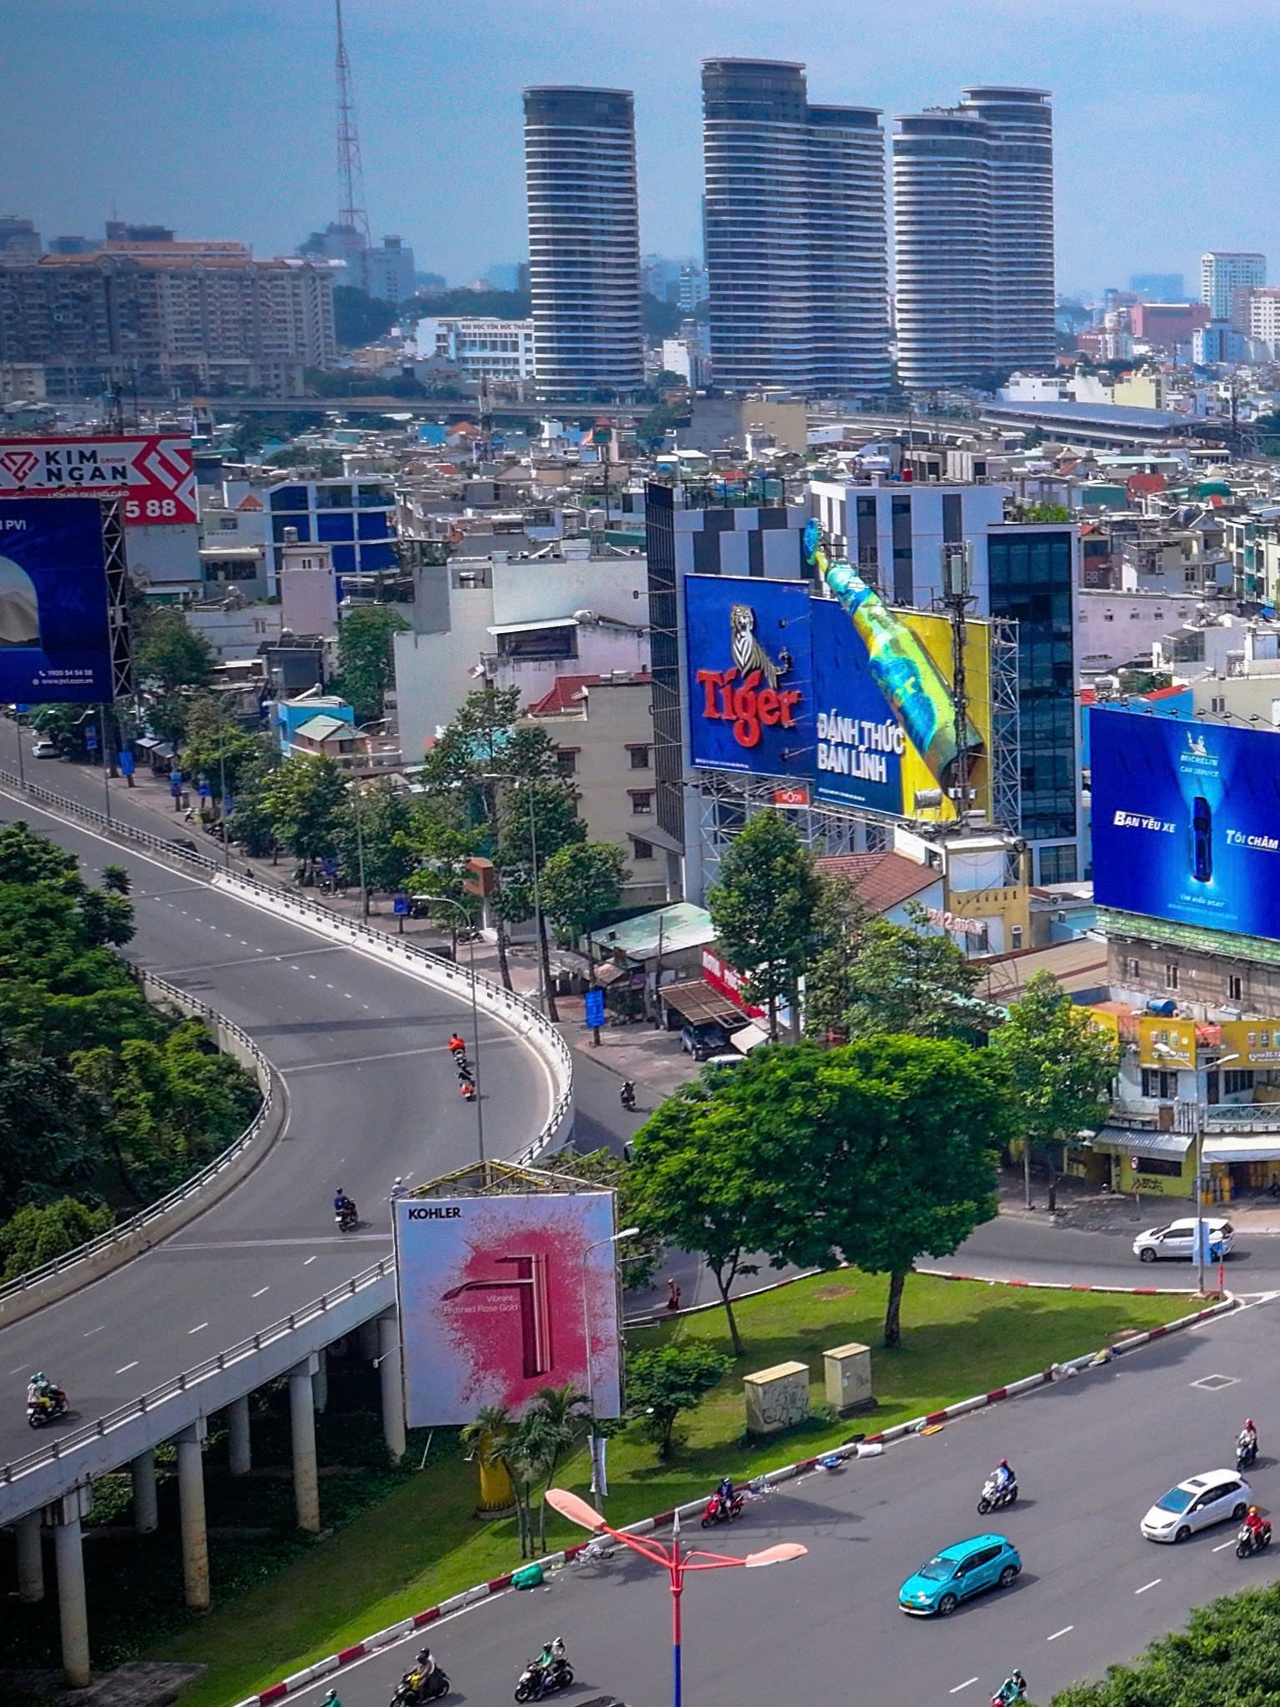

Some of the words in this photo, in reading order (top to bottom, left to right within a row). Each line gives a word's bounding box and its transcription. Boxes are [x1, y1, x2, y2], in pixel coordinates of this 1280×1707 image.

[45, 450, 97, 466] KIM
[46, 466, 128, 482] NGAN
[146, 499, 177, 517] 88
[6, 520, 26, 530] PVI
[696, 668, 801, 748] Tiger
[817, 709, 859, 746] ĐÁNH
[861, 719, 905, 755] THỨC
[817, 740, 848, 774] BẢN
[851, 745, 888, 783] LĨNH
[1180, 754, 1218, 767] MICHELIN
[1113, 810, 1139, 828] BẠN
[1142, 816, 1161, 831] YÊU
[1162, 823, 1176, 833] XE
[1226, 829, 1246, 844] TÔI
[1247, 833, 1278, 850] CHĂM
[408, 1207, 461, 1220] KOHLER
[500, 1303, 518, 1311] Gold
